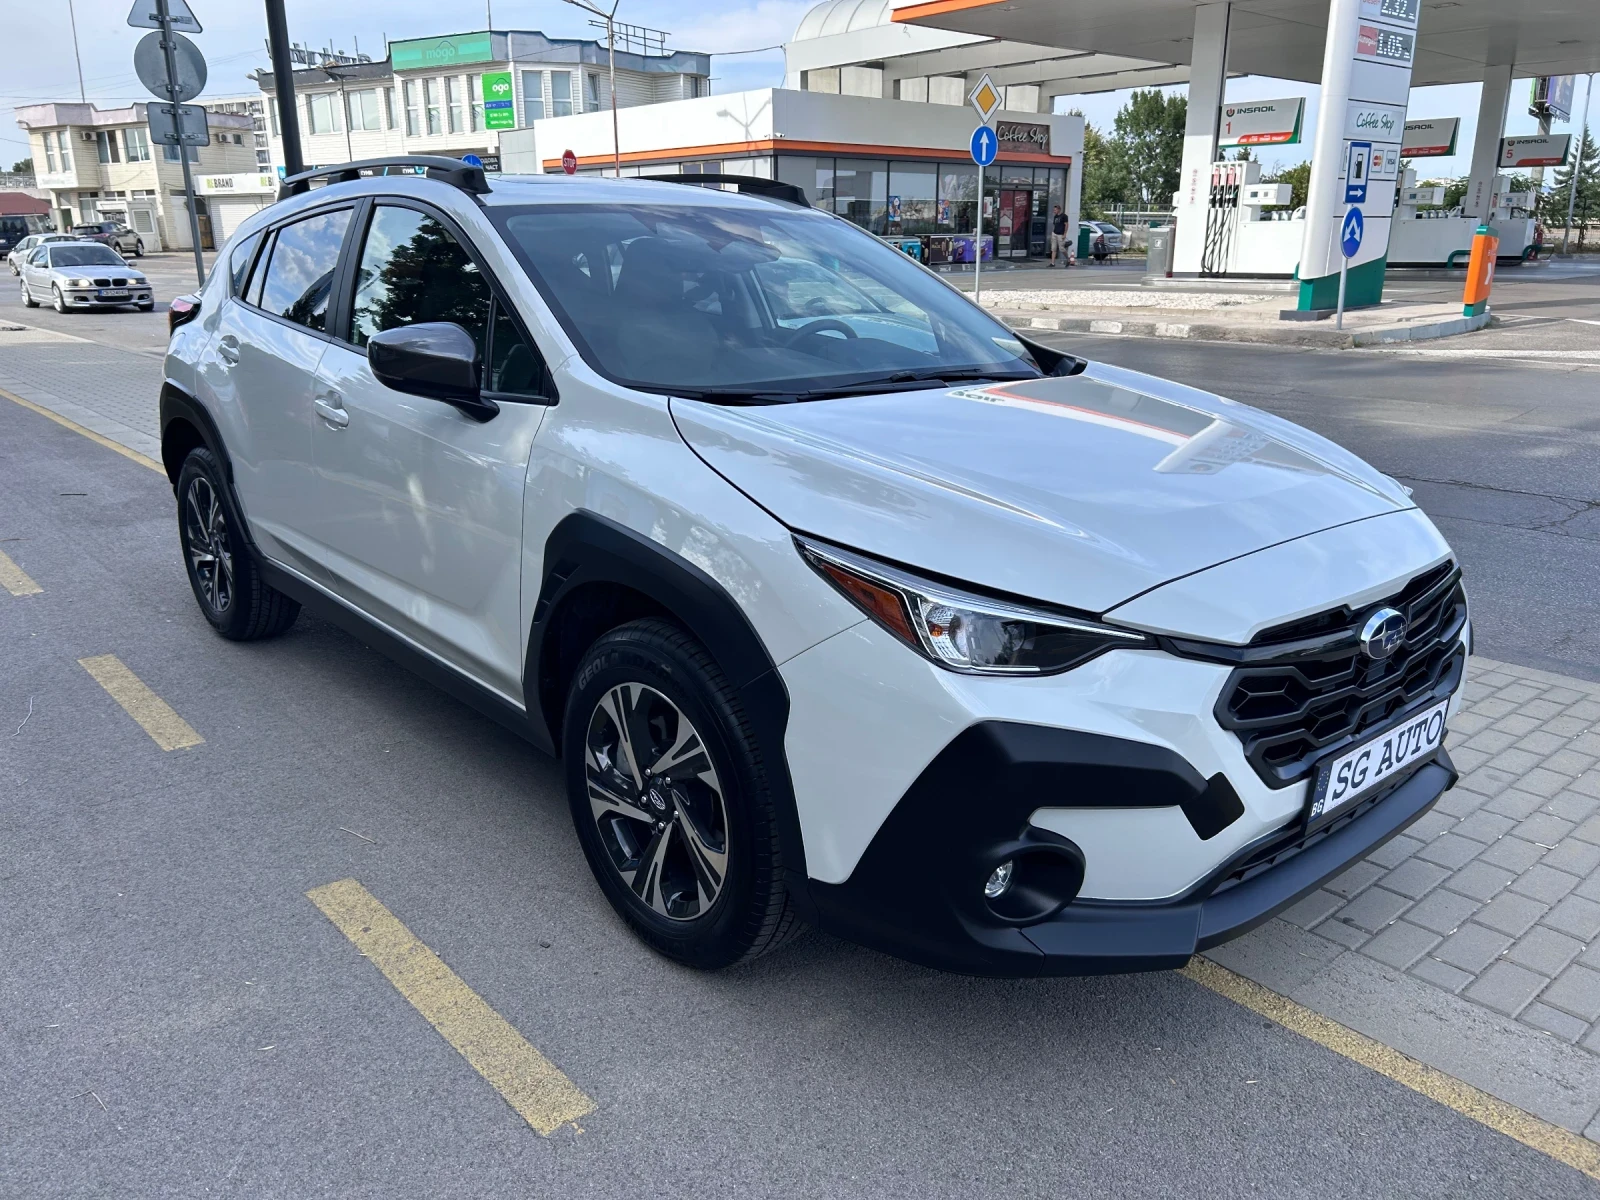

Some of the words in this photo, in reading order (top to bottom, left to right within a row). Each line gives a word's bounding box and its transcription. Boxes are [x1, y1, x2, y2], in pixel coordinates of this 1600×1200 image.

[1377, 33, 1403, 57] 1.05
[426, 47, 456, 62] mogo
[1237, 106, 1276, 114] INSAOIL
[1226, 122, 1231, 134] 1
[1356, 112, 1379, 129] Coffee
[1380, 114, 1395, 135] Shop
[998, 125, 1028, 142] Coffee
[1030, 127, 1048, 149] Shop
[1506, 149, 1513, 158] 5
[563, 157, 576, 168] STOP
[206, 178, 234, 188] REBRAND
[1332, 748, 1371, 801] SG
[1374, 709, 1443, 777] AUTO
[1311, 799, 1324, 817] BG
